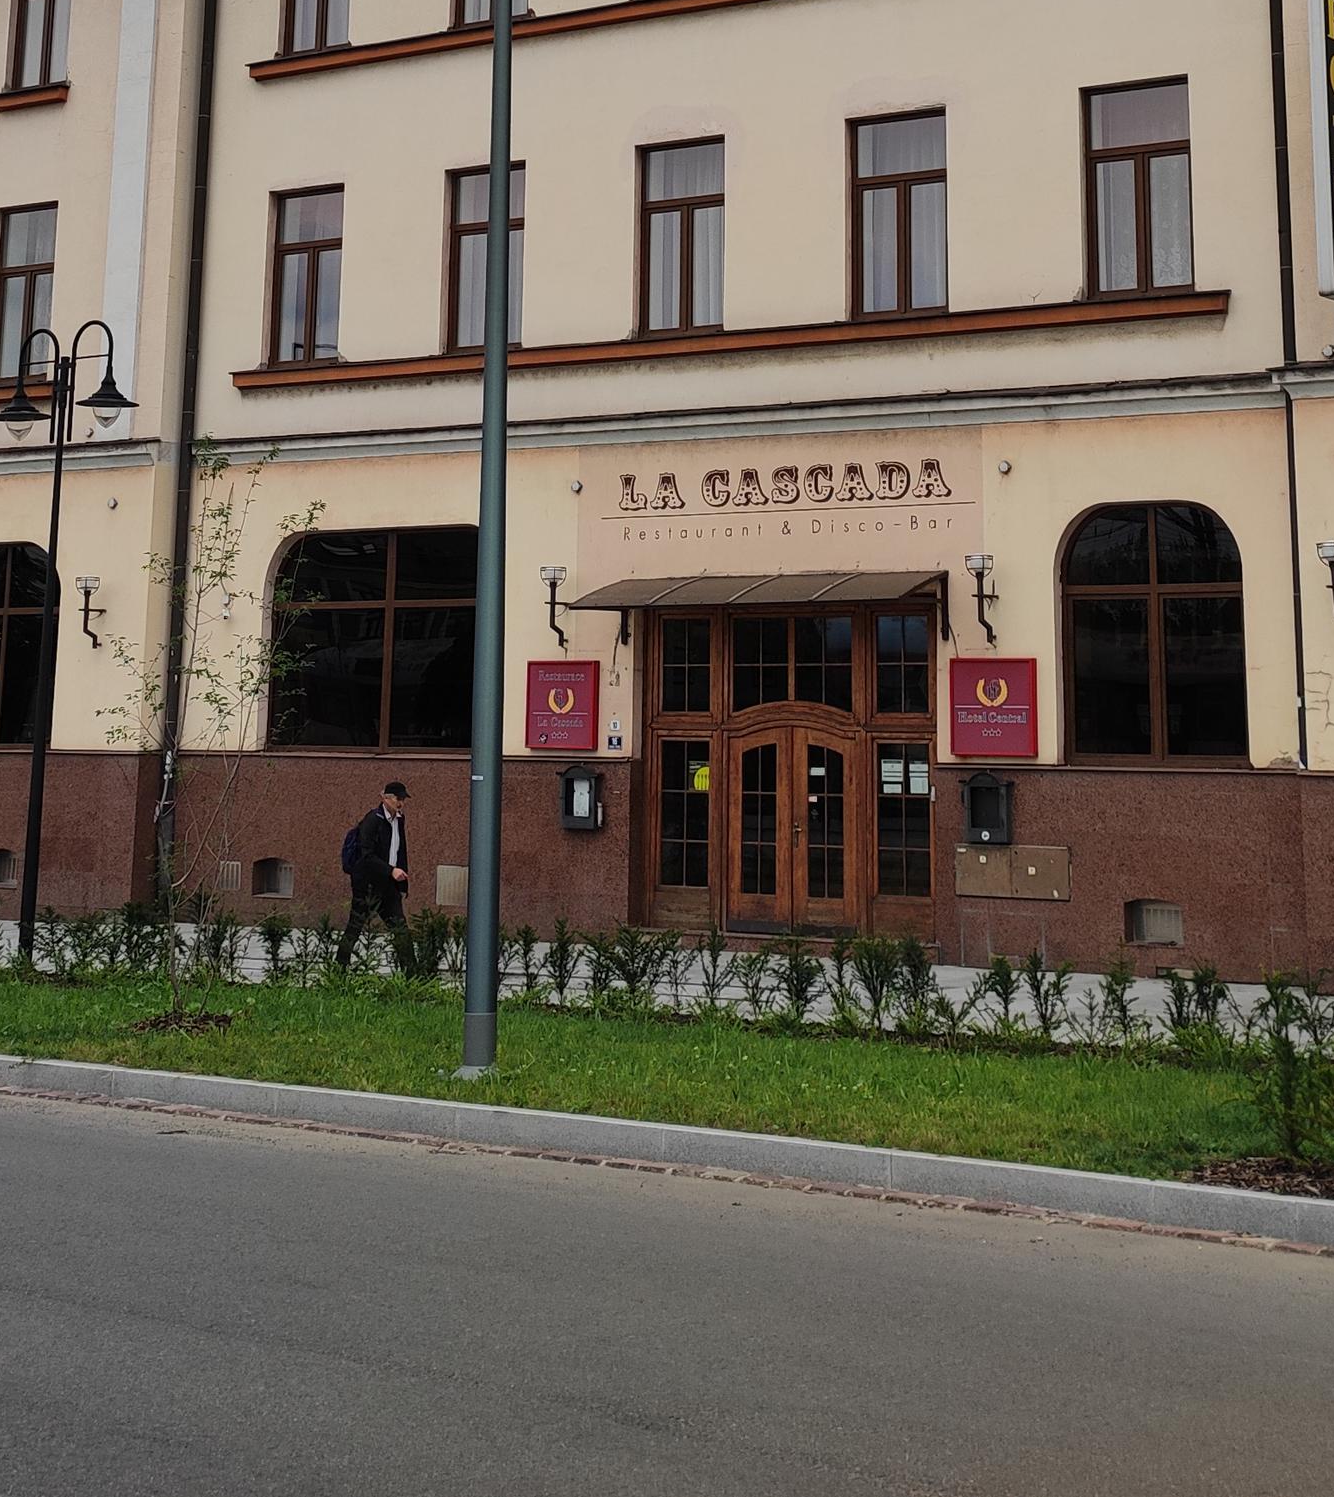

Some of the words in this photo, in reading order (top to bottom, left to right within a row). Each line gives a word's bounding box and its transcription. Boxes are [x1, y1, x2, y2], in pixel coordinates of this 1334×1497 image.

[619, 471, 686, 512] LA
[701, 457, 953, 508] CASCADA
[623, 522, 763, 542] Restaurant
[781, 520, 793, 536] &
[958, 711, 987, 723] Hotel
[988, 712, 1027, 724] Central
